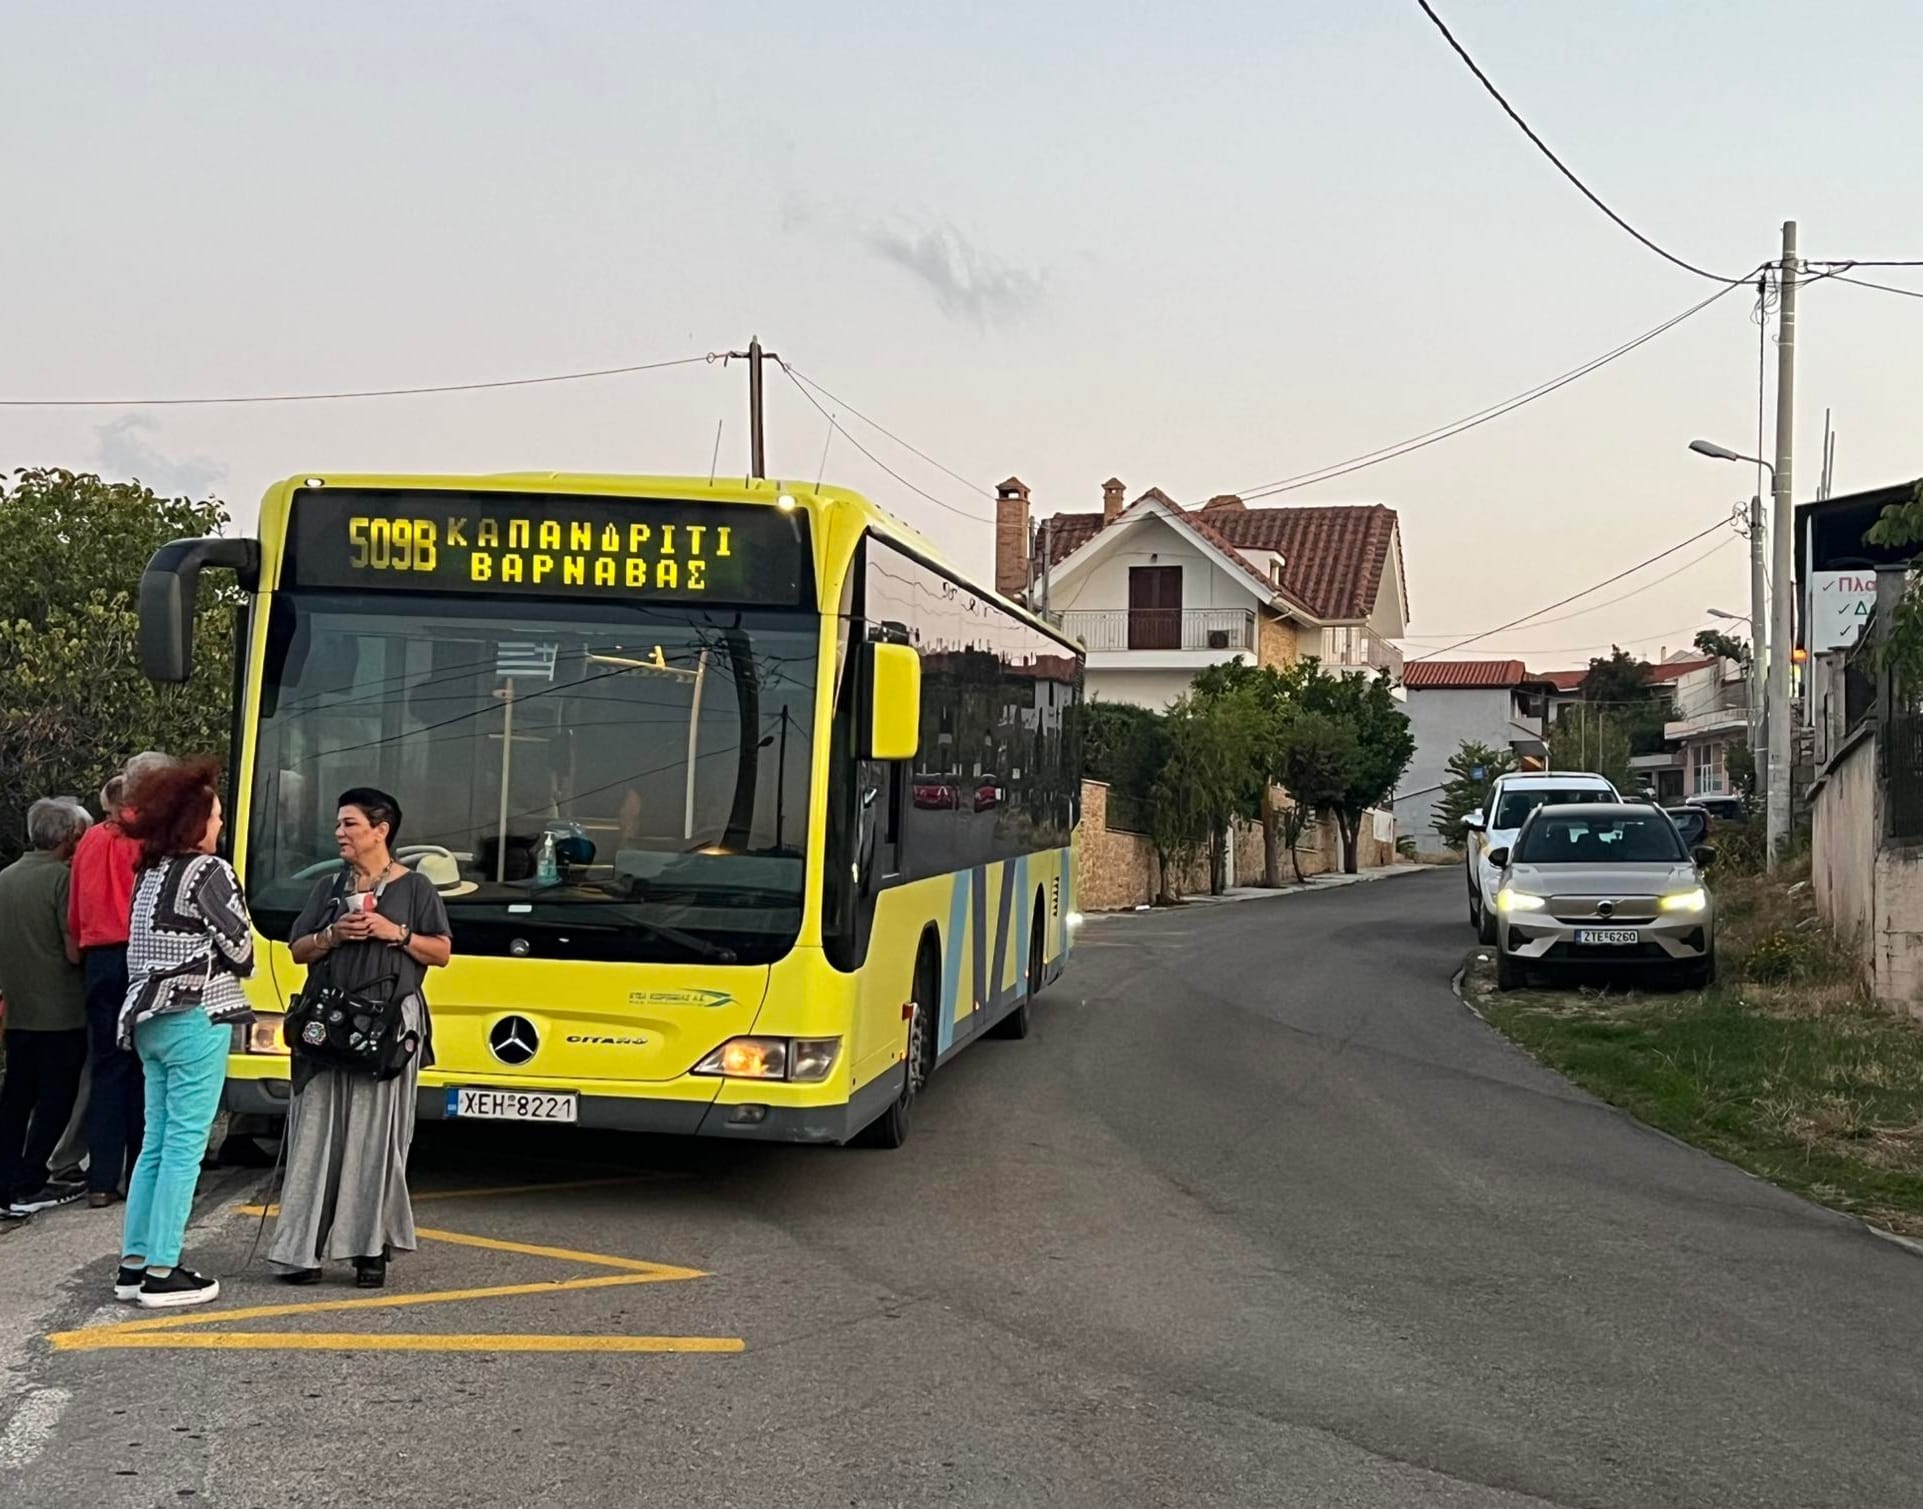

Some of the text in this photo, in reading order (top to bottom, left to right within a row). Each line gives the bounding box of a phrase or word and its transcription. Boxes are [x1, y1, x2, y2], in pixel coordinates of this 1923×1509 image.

[349, 516, 731, 571] 509B ΚΑΠΑΝΔΡΙΤΙ
[471, 552, 705, 589] ΒΑΡΝΑΒΑΣ
